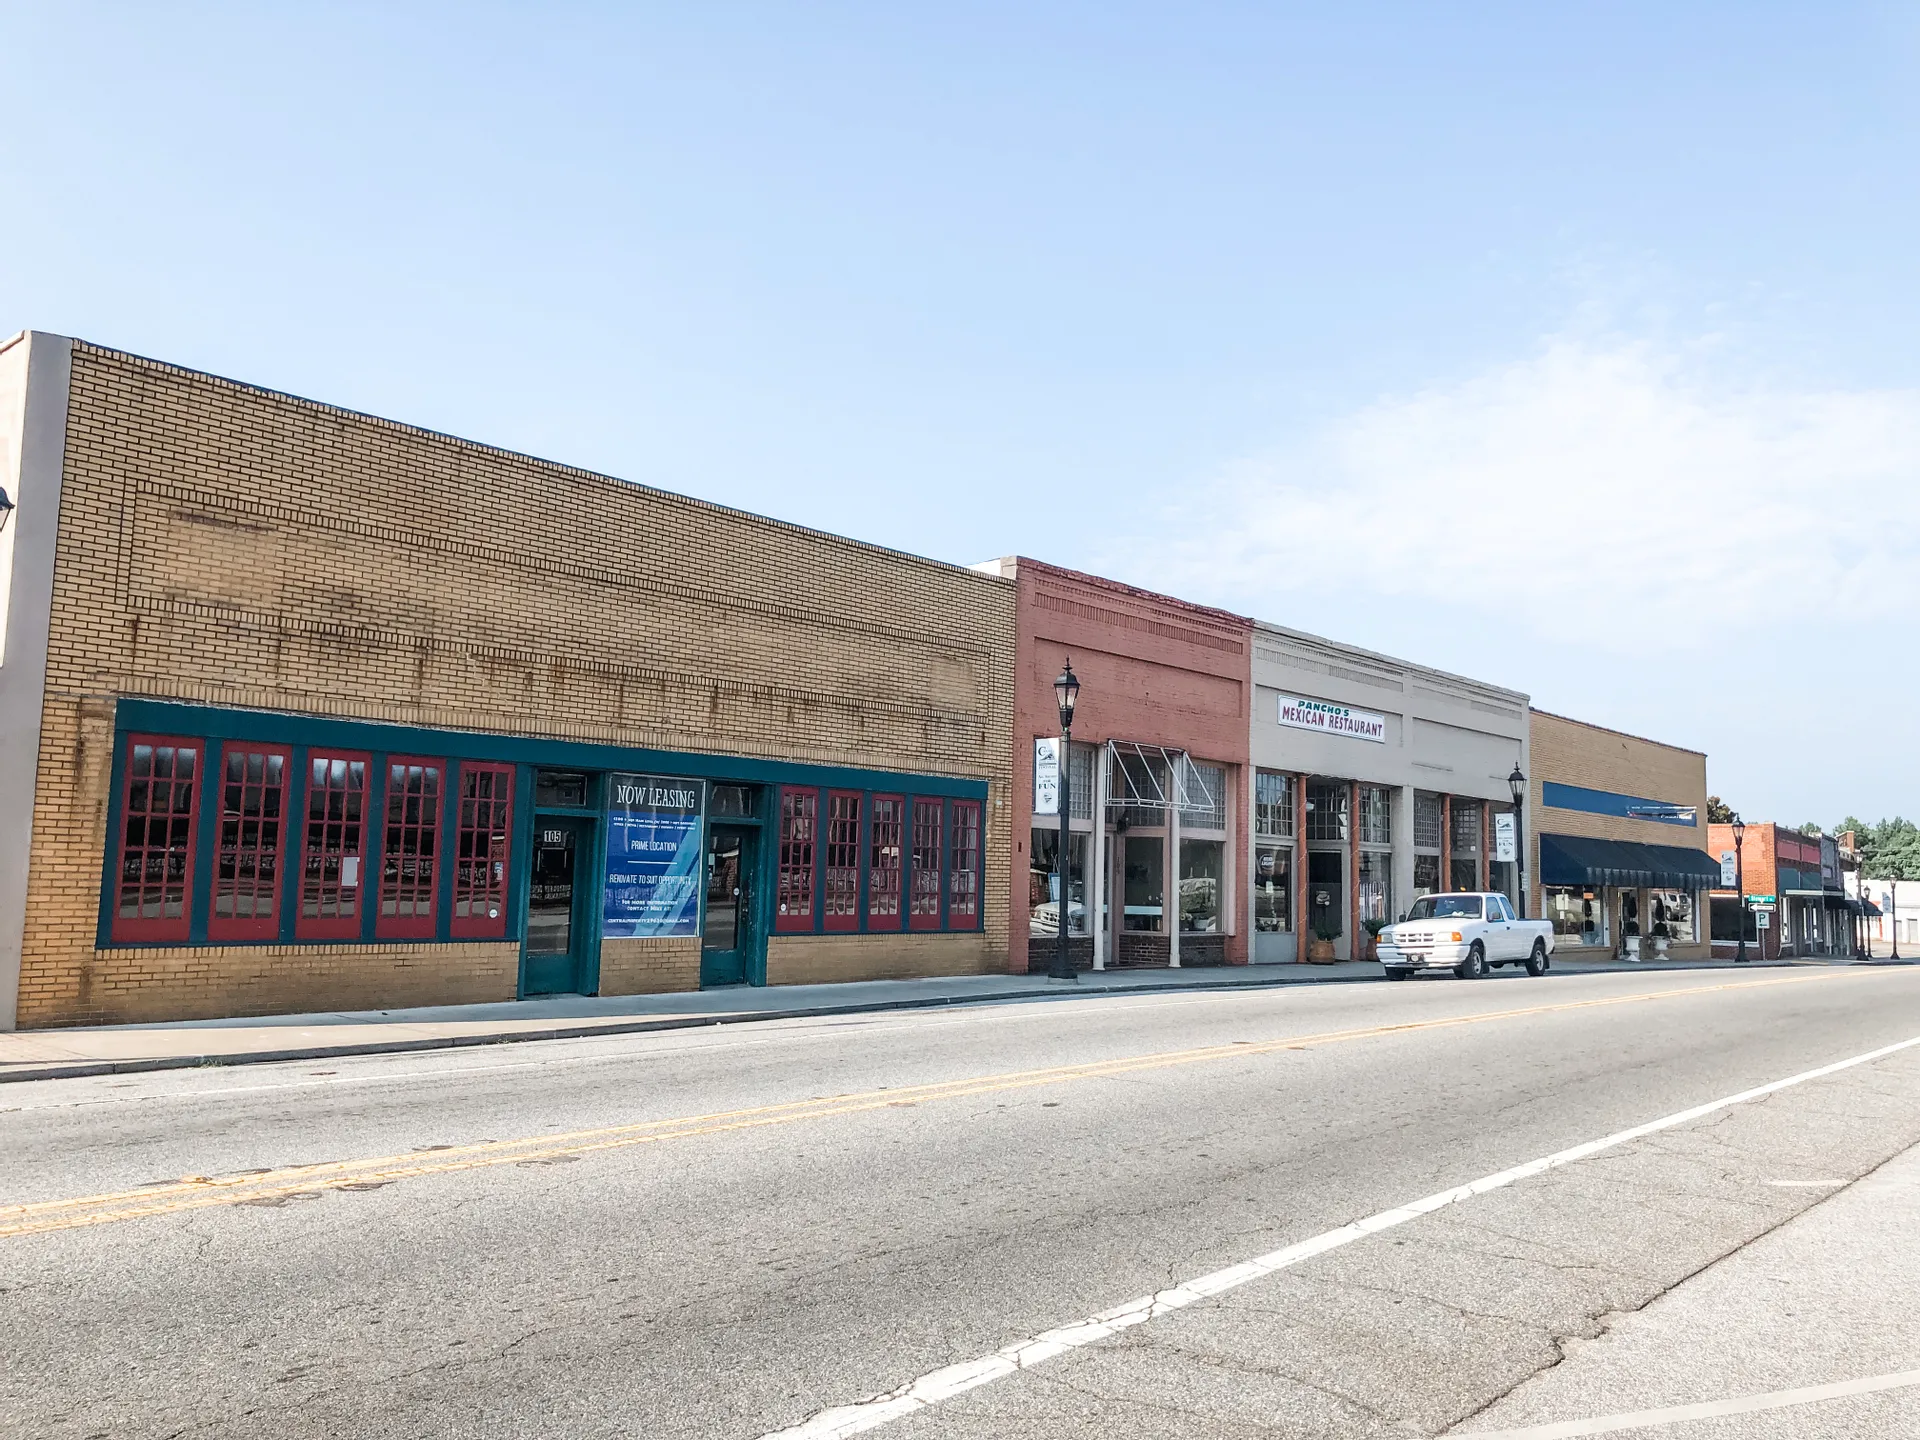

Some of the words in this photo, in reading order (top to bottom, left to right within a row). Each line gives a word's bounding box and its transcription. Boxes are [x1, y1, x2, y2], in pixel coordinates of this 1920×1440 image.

[1297, 700, 1350, 717] PANCHO'S
[1282, 705, 1325, 727] MEXICAN
[1328, 715, 1383, 737] RESTAURANT
[616, 784, 647, 805] NOW
[648, 787, 695, 808] LEASING
[545, 831, 560, 842] 105
[631, 840, 648, 851] PRIME
[649, 841, 677, 852] LOCATION
[609, 874, 638, 884] RENOVATE
[638, 875, 647, 884] TO
[646, 875, 658, 885] SUIT
[1758, 913, 1766, 923] P
